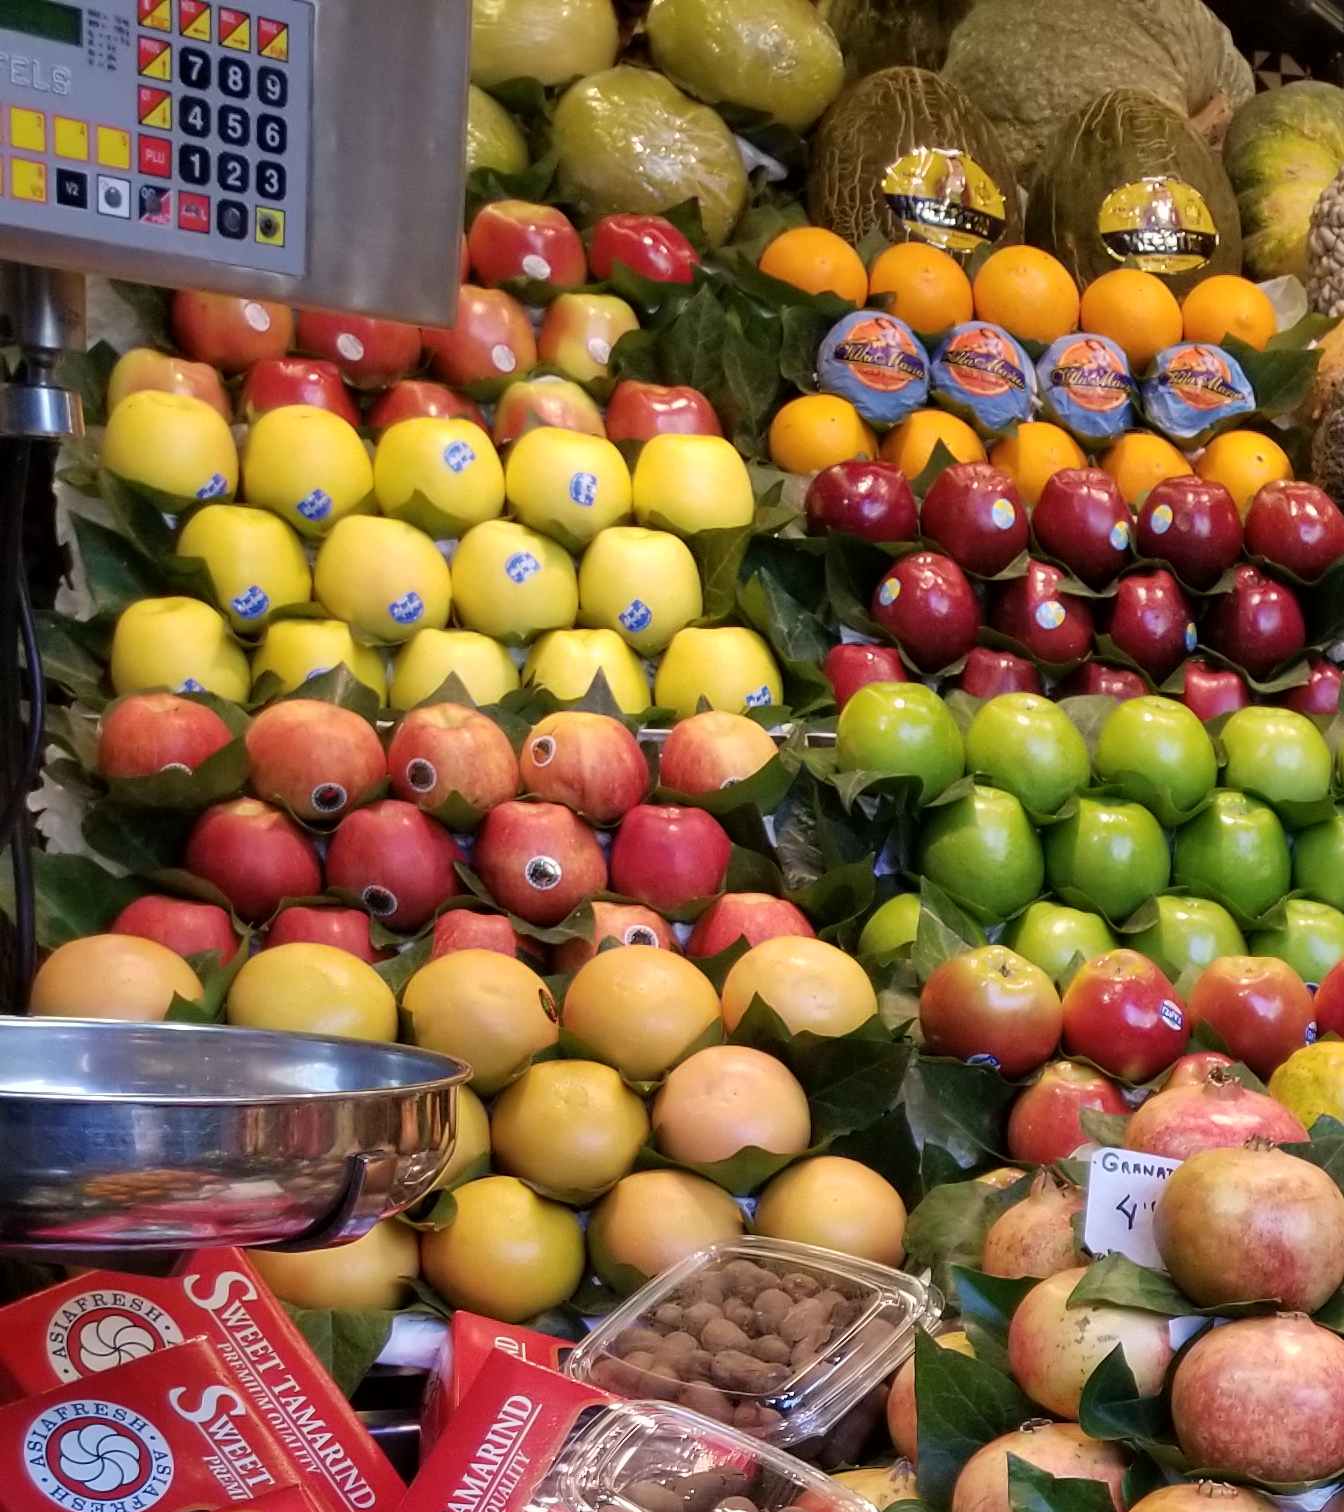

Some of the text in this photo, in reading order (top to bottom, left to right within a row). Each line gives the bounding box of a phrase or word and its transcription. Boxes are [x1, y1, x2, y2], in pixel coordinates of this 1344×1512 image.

[188, 55, 281, 101] 7 8 9
[187, 106, 280, 148] 4 5 6
[190, 153, 201, 178] 1
[227, 160, 242, 187] 2
[265, 168, 279, 193] 3
[1160, 1000, 1184, 1027] KANZI
[49, 1292, 163, 1360] ASIAFRESH
[183, 1271, 377, 1511] SWEET TAMARIND
[217, 1342, 268, 1410] PREMIUM
[28, 1402, 149, 1467] ASIAFRESH
[169, 1385, 276, 1489] SWEET
